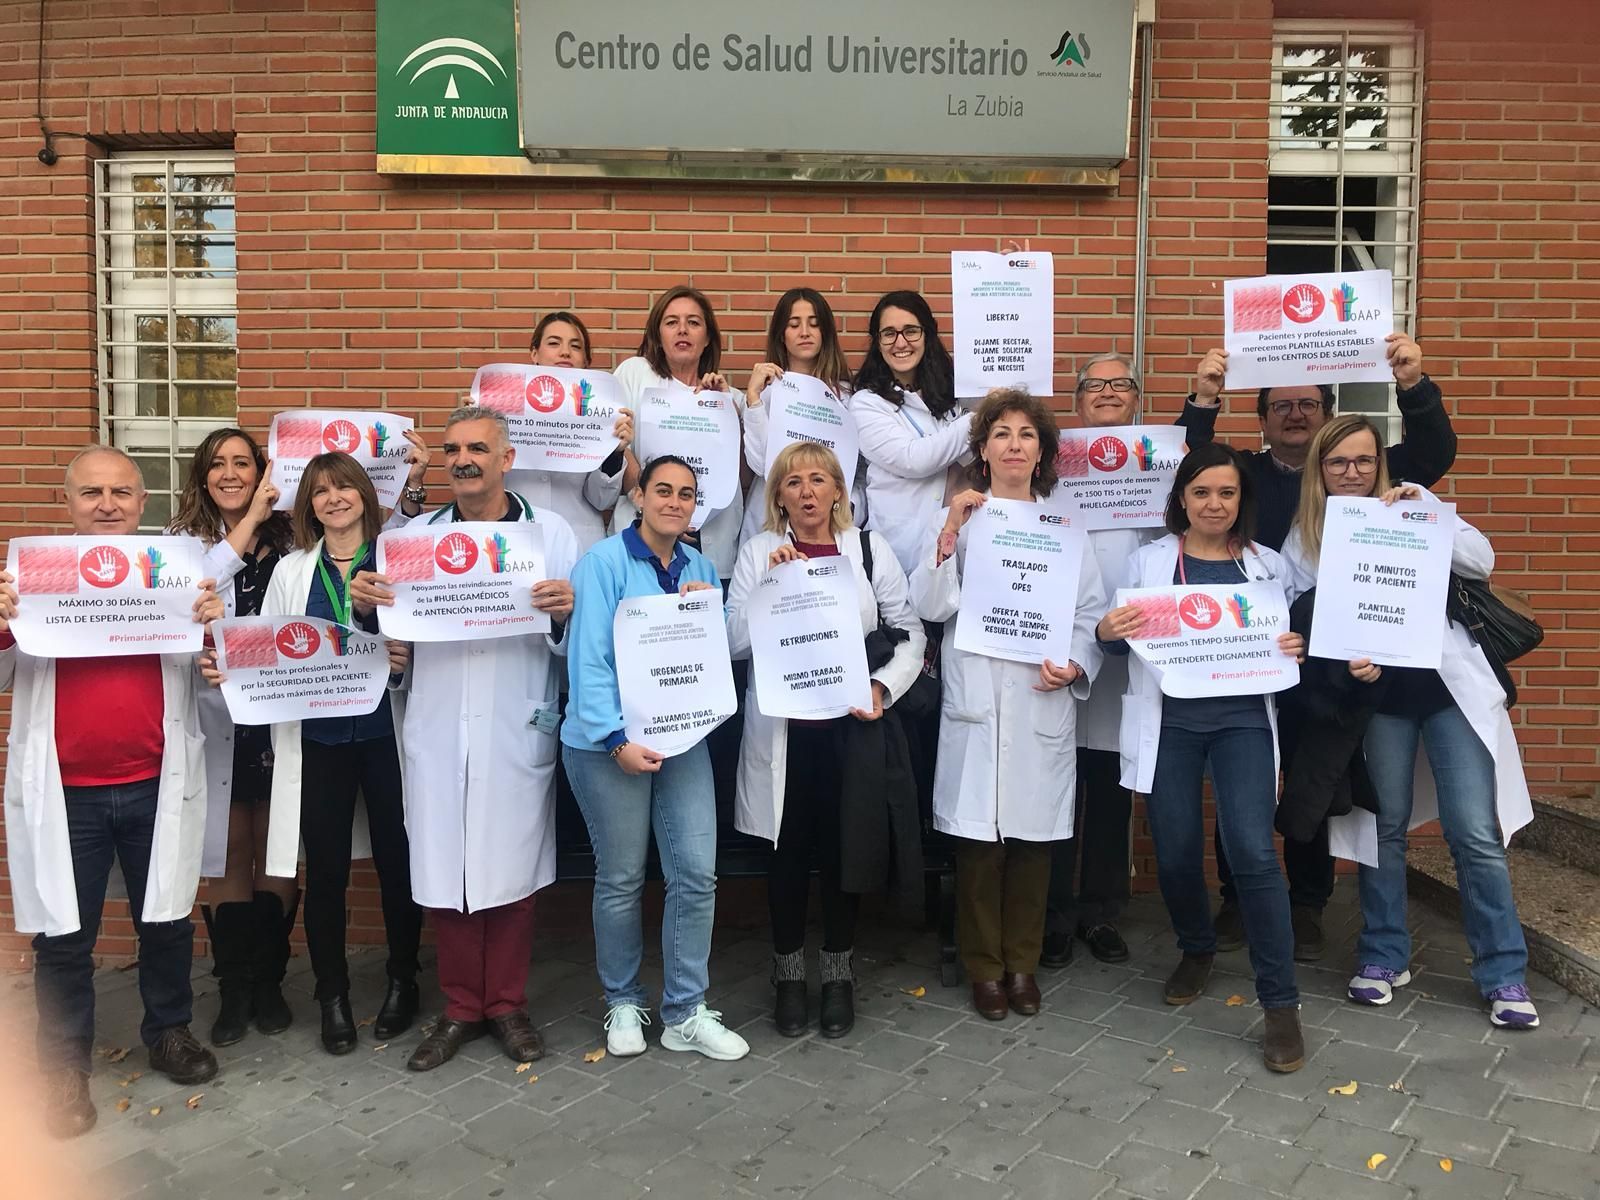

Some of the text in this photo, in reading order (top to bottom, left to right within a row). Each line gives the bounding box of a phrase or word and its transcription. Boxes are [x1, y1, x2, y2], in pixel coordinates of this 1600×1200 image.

[555, 31, 1028, 77] Centro de Salud Universitario
[395, 106, 428, 118] JUNTA
[434, 106, 446, 118] DE
[947, 95, 1024, 118] La Zubia
[1259, 333, 1295, 341] Pacientes
[1304, 328, 1357, 338] profesionales
[1289, 341, 1334, 350] PLANTILLAS
[1337, 338, 1374, 347] ESTABLES
[1282, 352, 1317, 360] CENTROS
[1332, 350, 1359, 358] SALUD
[1307, 361, 1376, 372] #PrimariaPrimero
[536, 420, 568, 429] minutos
[534, 431, 571, 440] Comunitaria,
[1080, 499, 1147, 509] #HUELGAMÉDICOS
[1002, 559, 1048, 572] TRASLADOS
[1358, 563, 1416, 577] 10 MINUTOS
[411, 584, 446, 592] Apoyamos
[459, 580, 512, 588] reivindicaciones
[1012, 582, 1031, 592] OPES
[1353, 574, 1416, 589] POR PACIENTE
[58, 598, 103, 607] MÁXIMO
[120, 598, 142, 607] DÍAS
[434, 591, 509, 602] #HUELGAMÉDICOS
[425, 604, 472, 615] ANTENCIÓN
[475, 604, 515, 613] PRIMARIA
[992, 607, 1044, 621] OFERTA TODO,
[1358, 602, 1405, 615] PLANTILLAS
[46, 616, 71, 624] LISTA
[90, 615, 126, 623] ESPERA
[128, 613, 165, 625] pruebas
[464, 615, 534, 627] #PrimariaPrimero
[983, 616, 1052, 632] CONVOCA SIEMPRE,
[1358, 613, 1404, 625] ADECUADAS
[985, 625, 1018, 636] RESUELVE
[109, 633, 187, 643] #PrimariaPrimero
[780, 630, 839, 647] RETRIBUCIONES
[1147, 633, 1270, 650] Queremos TIEMPO SUFICIENTE
[1168, 655, 1214, 665] ATENDERTE
[1217, 650, 1271, 661] DIGNAMENTE
[289, 663, 341, 675] profesionales
[650, 663, 704, 676] URGENCIAS DE
[784, 666, 846, 682] MISMO TRABAJO,
[1211, 669, 1282, 680] #PrimariaPrimero
[267, 677, 313, 688] SEGURIDAD
[332, 673, 371, 682] PACIENTE:
[659, 675, 698, 687] PRIMARIA
[791, 676, 843, 691] MISMO SUELDO
[249, 692, 284, 702] Jornadas
[287, 688, 322, 698] máximas
[309, 698, 373, 708] #PrimariaPrimero
[652, 709, 715, 724] SALVAMOS VIDAS,
[644, 723, 679, 736] RECONOCE
[681, 722, 691, 731] MI
